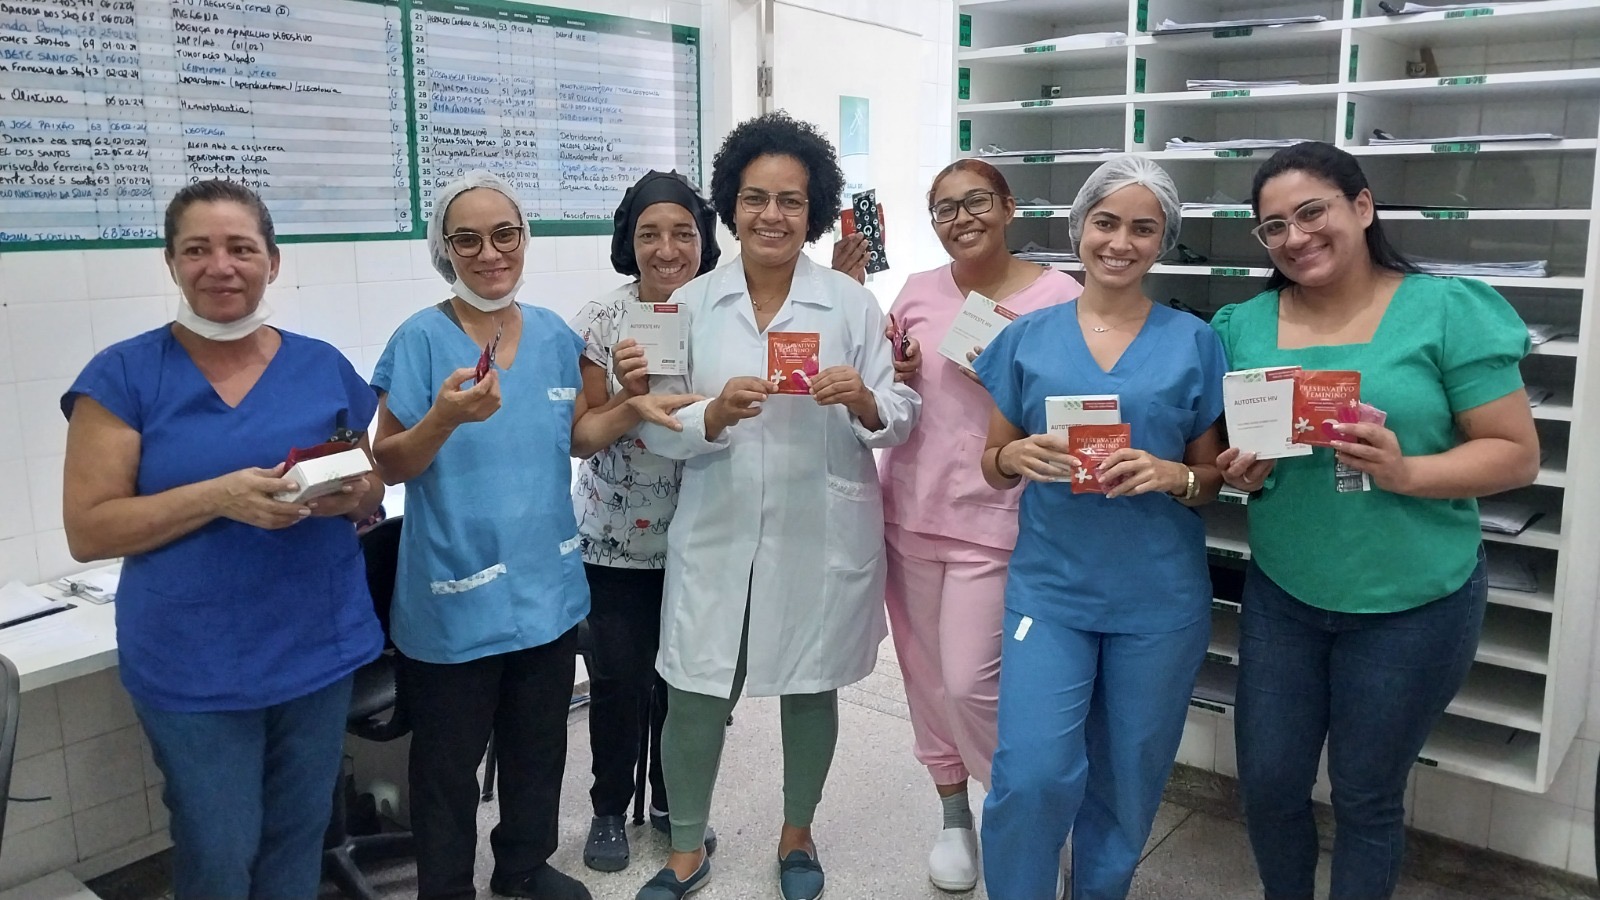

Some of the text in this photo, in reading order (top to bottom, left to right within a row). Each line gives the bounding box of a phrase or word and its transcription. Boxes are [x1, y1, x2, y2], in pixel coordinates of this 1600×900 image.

[172, 8, 218, 21] MELENA
[175, 21, 211, 34] DOENÇA
[82, 38, 95, 49] 69
[38, 52, 78, 63] SANTOS
[85, 66, 98, 77] 43
[94, 137, 111, 145] 62
[15, 148, 34, 157] DOS
[38, 149, 70, 158] SANTOS
[96, 162, 110, 171] 63
[97, 175, 110, 185] 69
[102, 229, 119, 238] 68
[1300, 385, 1355, 393] PRESERVATIVO
[1234, 396, 1267, 406] AUTOTESTE
